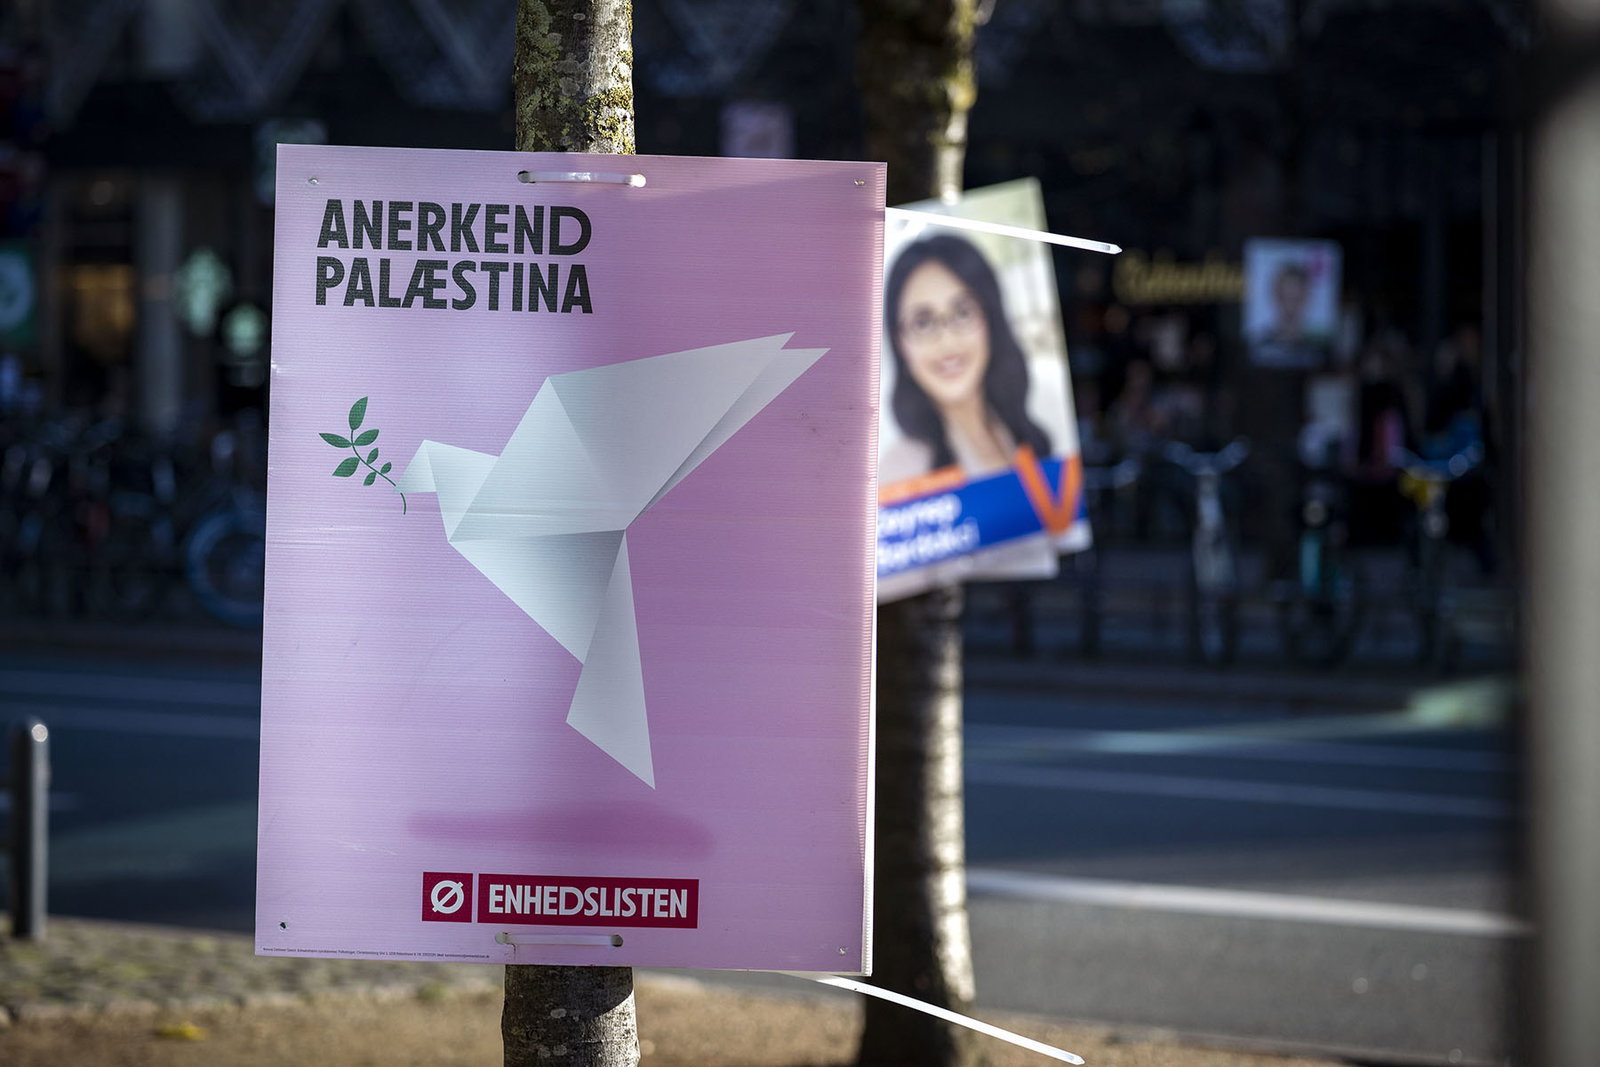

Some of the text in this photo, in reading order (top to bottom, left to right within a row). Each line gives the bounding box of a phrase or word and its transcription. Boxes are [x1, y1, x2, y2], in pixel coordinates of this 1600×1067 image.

[317, 199, 592, 256] ANERKEND
[315, 256, 593, 314] PALÆSTINA
[431, 880, 688, 918] Ø ENHEDSLISTEN
